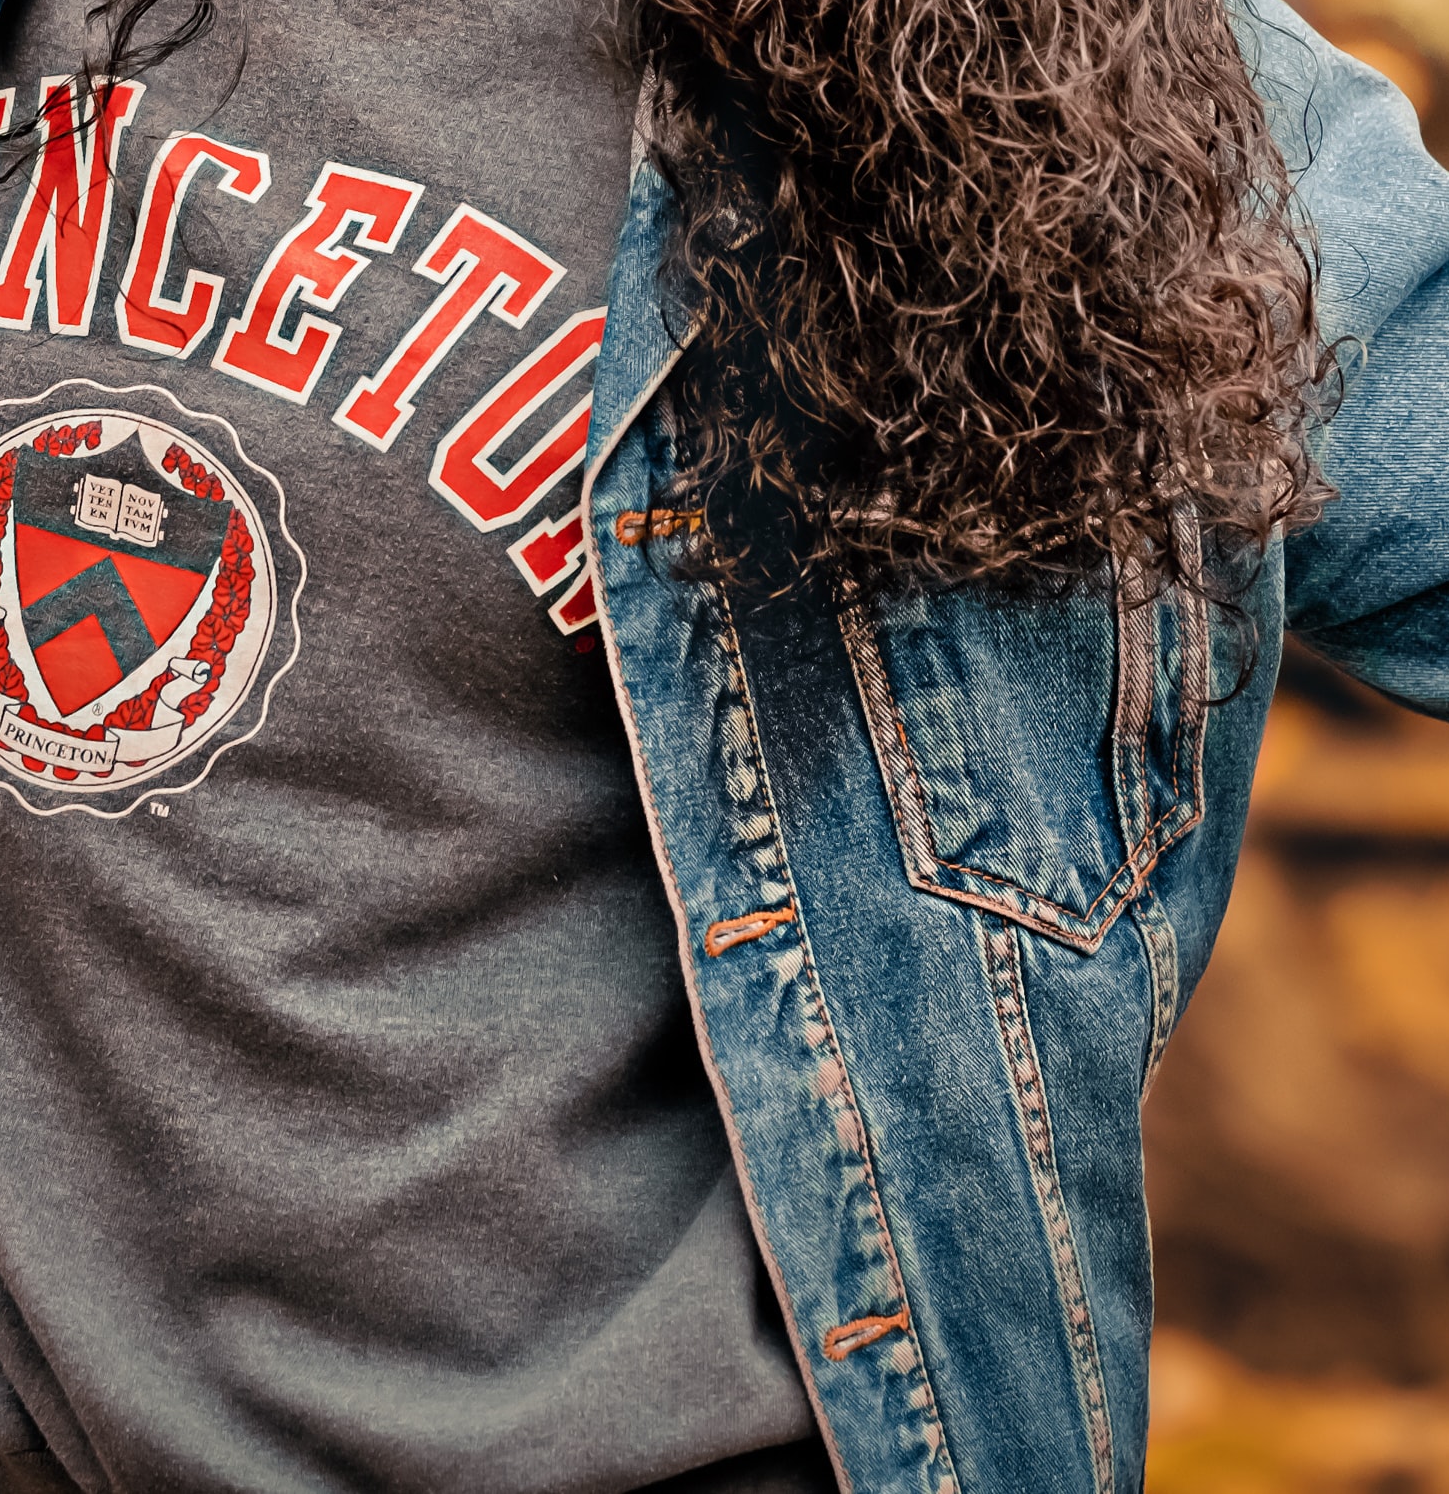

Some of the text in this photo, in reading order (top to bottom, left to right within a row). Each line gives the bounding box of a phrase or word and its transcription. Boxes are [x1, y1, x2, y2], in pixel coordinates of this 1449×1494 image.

[90, 482, 115, 497] VET
[128, 493, 156, 508] NOV
[90, 507, 108, 520] EN
[125, 505, 153, 521] TAM
[123, 517, 151, 533] TVM
[4, 722, 108, 765] PRINCETON
